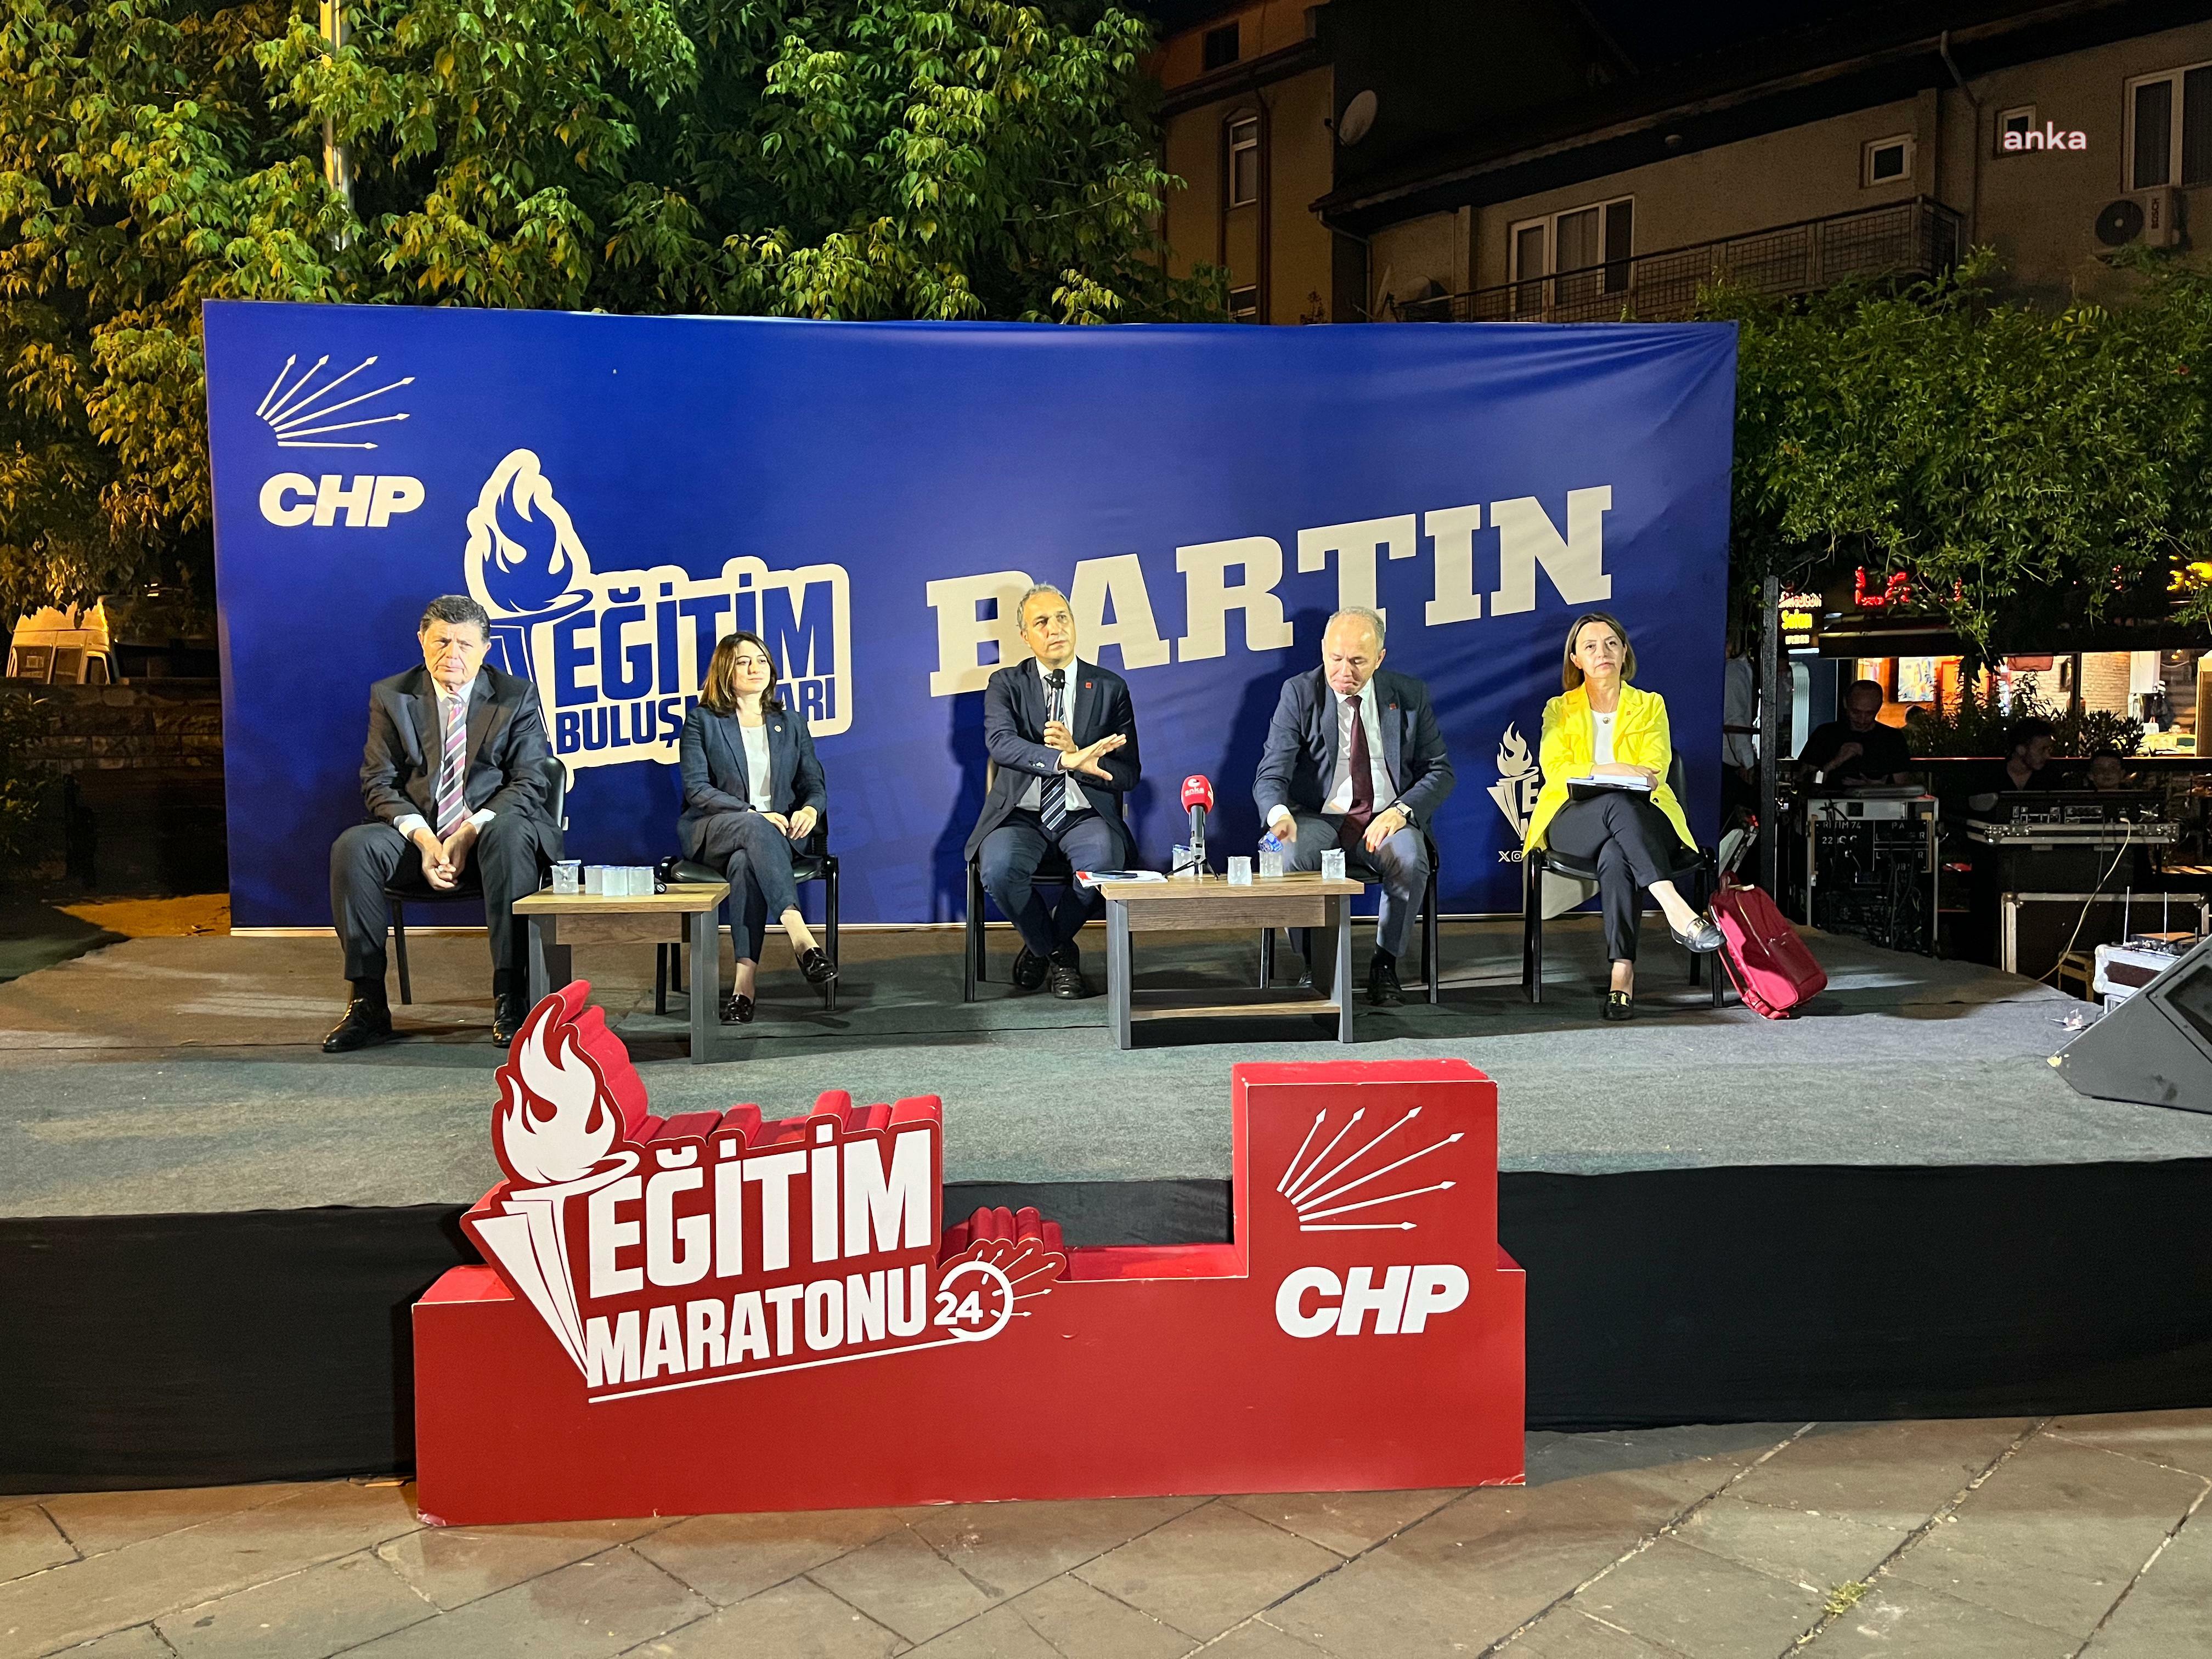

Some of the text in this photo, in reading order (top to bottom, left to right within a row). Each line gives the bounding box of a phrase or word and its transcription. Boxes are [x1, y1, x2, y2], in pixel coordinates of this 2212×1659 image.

[259, 472, 425, 527] CHP
[556, 677, 836, 755] BULUŞARI
[588, 1124, 931, 1299] EĞİTİM
[587, 1263, 983, 1387] MARATONU 24
[1275, 1264, 1470, 1339] CHP
